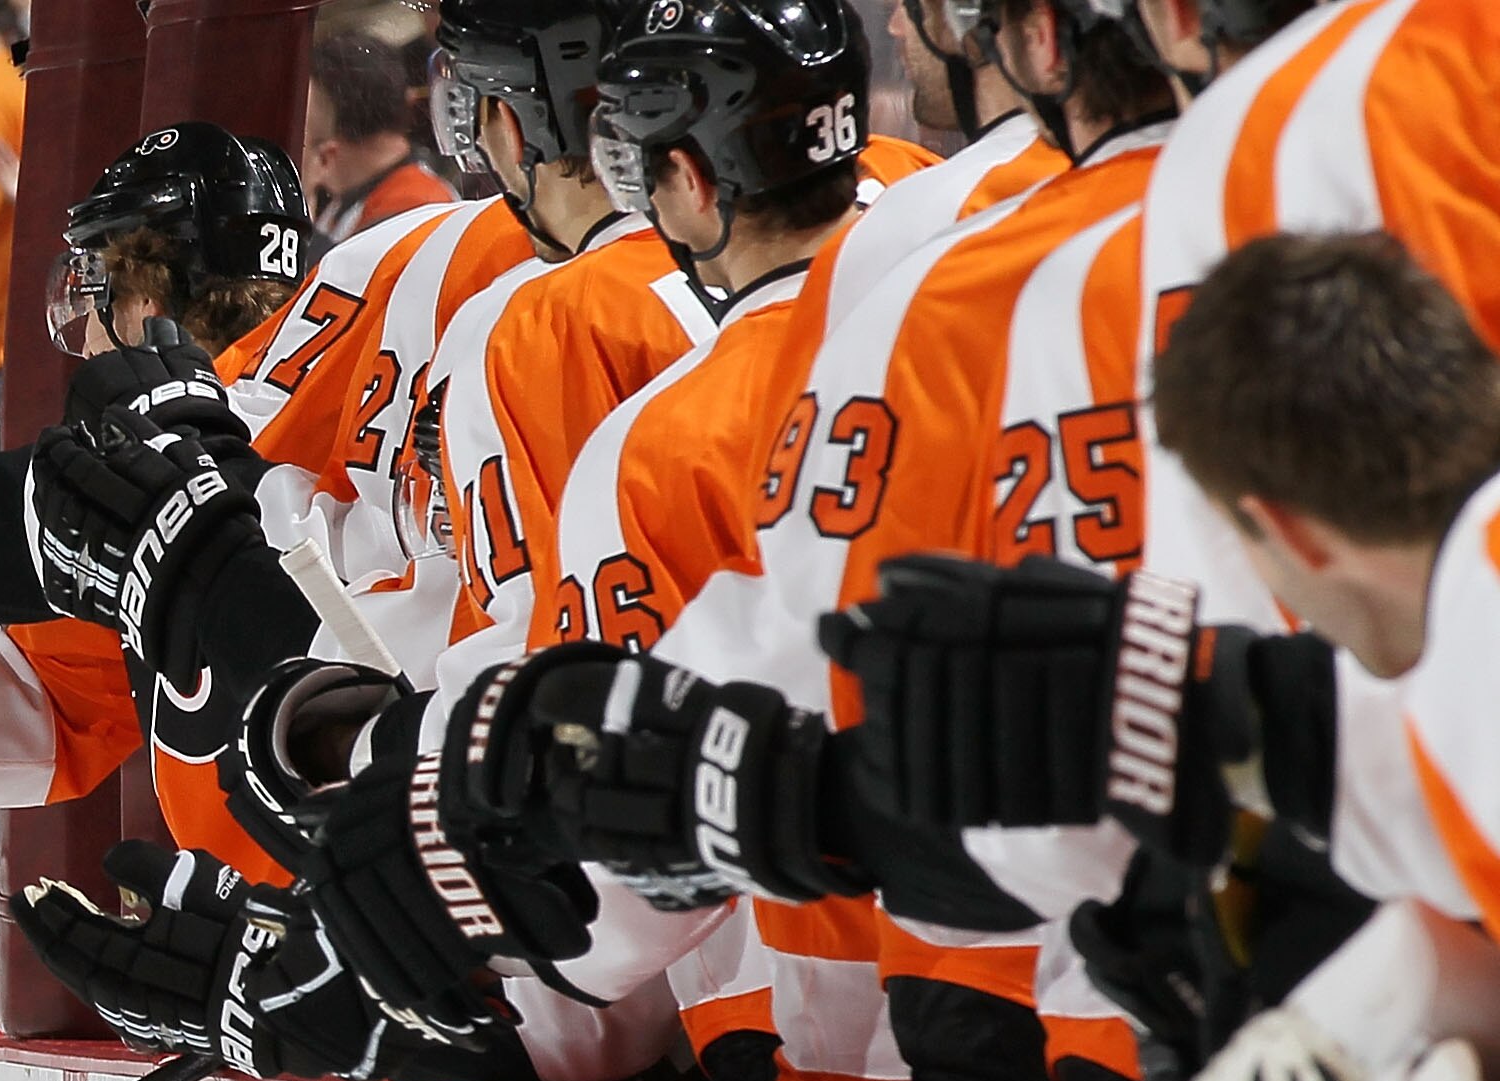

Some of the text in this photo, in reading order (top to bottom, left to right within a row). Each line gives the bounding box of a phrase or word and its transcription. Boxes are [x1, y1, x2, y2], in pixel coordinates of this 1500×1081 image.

[805, 93, 858, 163] 36
[260, 223, 298, 278] 28
[755, 391, 899, 540] 93
[994, 402, 1144, 564] 25
[118, 470, 229, 661] BAUER
